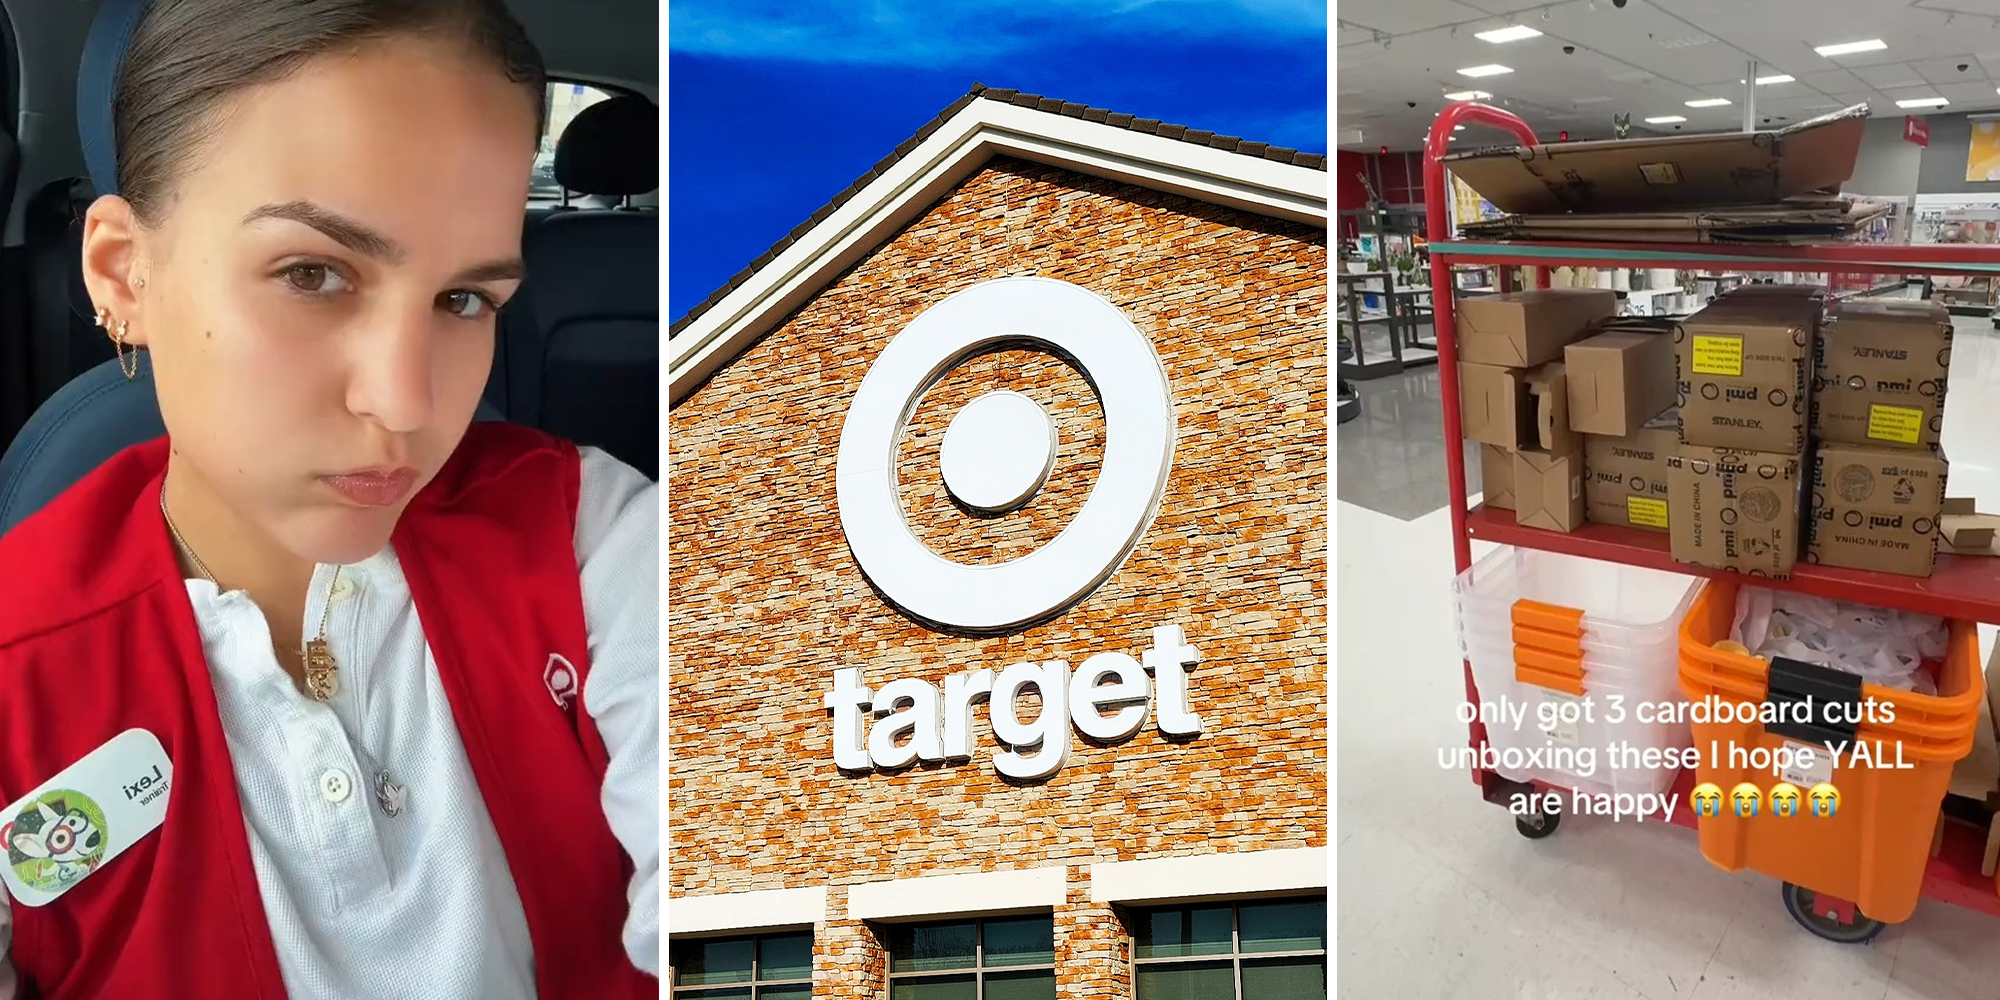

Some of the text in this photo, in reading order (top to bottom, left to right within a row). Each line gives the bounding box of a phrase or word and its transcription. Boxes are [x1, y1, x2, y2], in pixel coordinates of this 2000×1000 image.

[1726, 387, 1757, 402] pmi
[1597, 472, 1622, 484] pmi
[1692, 482, 1702, 548] MADE IN CHINA
[1869, 515, 1903, 530] pmi
[1721, 529, 1738, 558] pmi
[1835, 535, 1910, 550] MADE IN CHINA
[824, 624, 1203, 780] target
